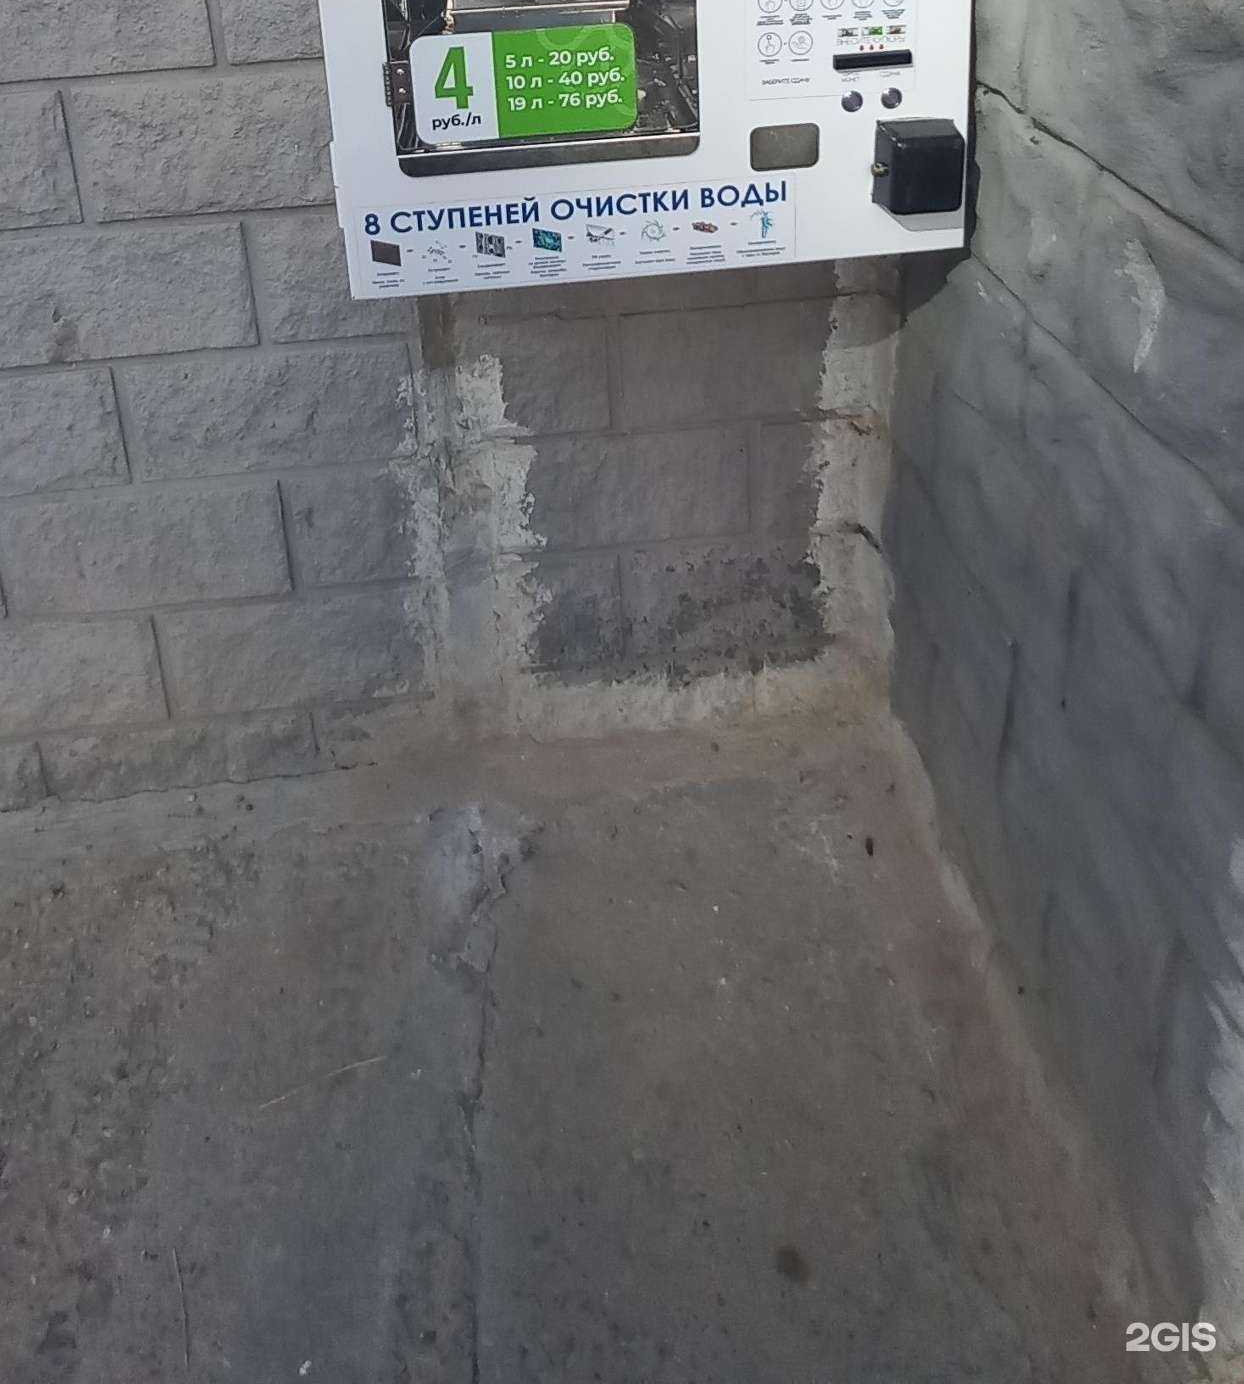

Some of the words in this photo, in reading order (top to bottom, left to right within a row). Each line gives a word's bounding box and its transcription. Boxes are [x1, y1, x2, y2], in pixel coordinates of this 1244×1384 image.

[505, 54, 516, 68] 5
[521, 57, 533, 68] л
[549, 51, 572, 65] 20
[576, 47, 614, 66] руб.
[434, 46, 474, 109] 4
[506, 75, 525, 90] 10
[530, 77, 542, 88] л
[558, 71, 583, 86] 40
[587, 67, 625, 87] руб.
[508, 97, 526, 111] 19
[530, 99, 543, 110] л
[559, 93, 580, 108] 76
[585, 89, 623, 108] руб.
[432, 112, 482, 130] руб./л
[364, 213, 381, 235] 8
[390, 196, 540, 233] СТУПЕНЕЙ
[550, 188, 689, 221] ОЧИСТКИ
[700, 180, 787, 208] ВОДЫ
